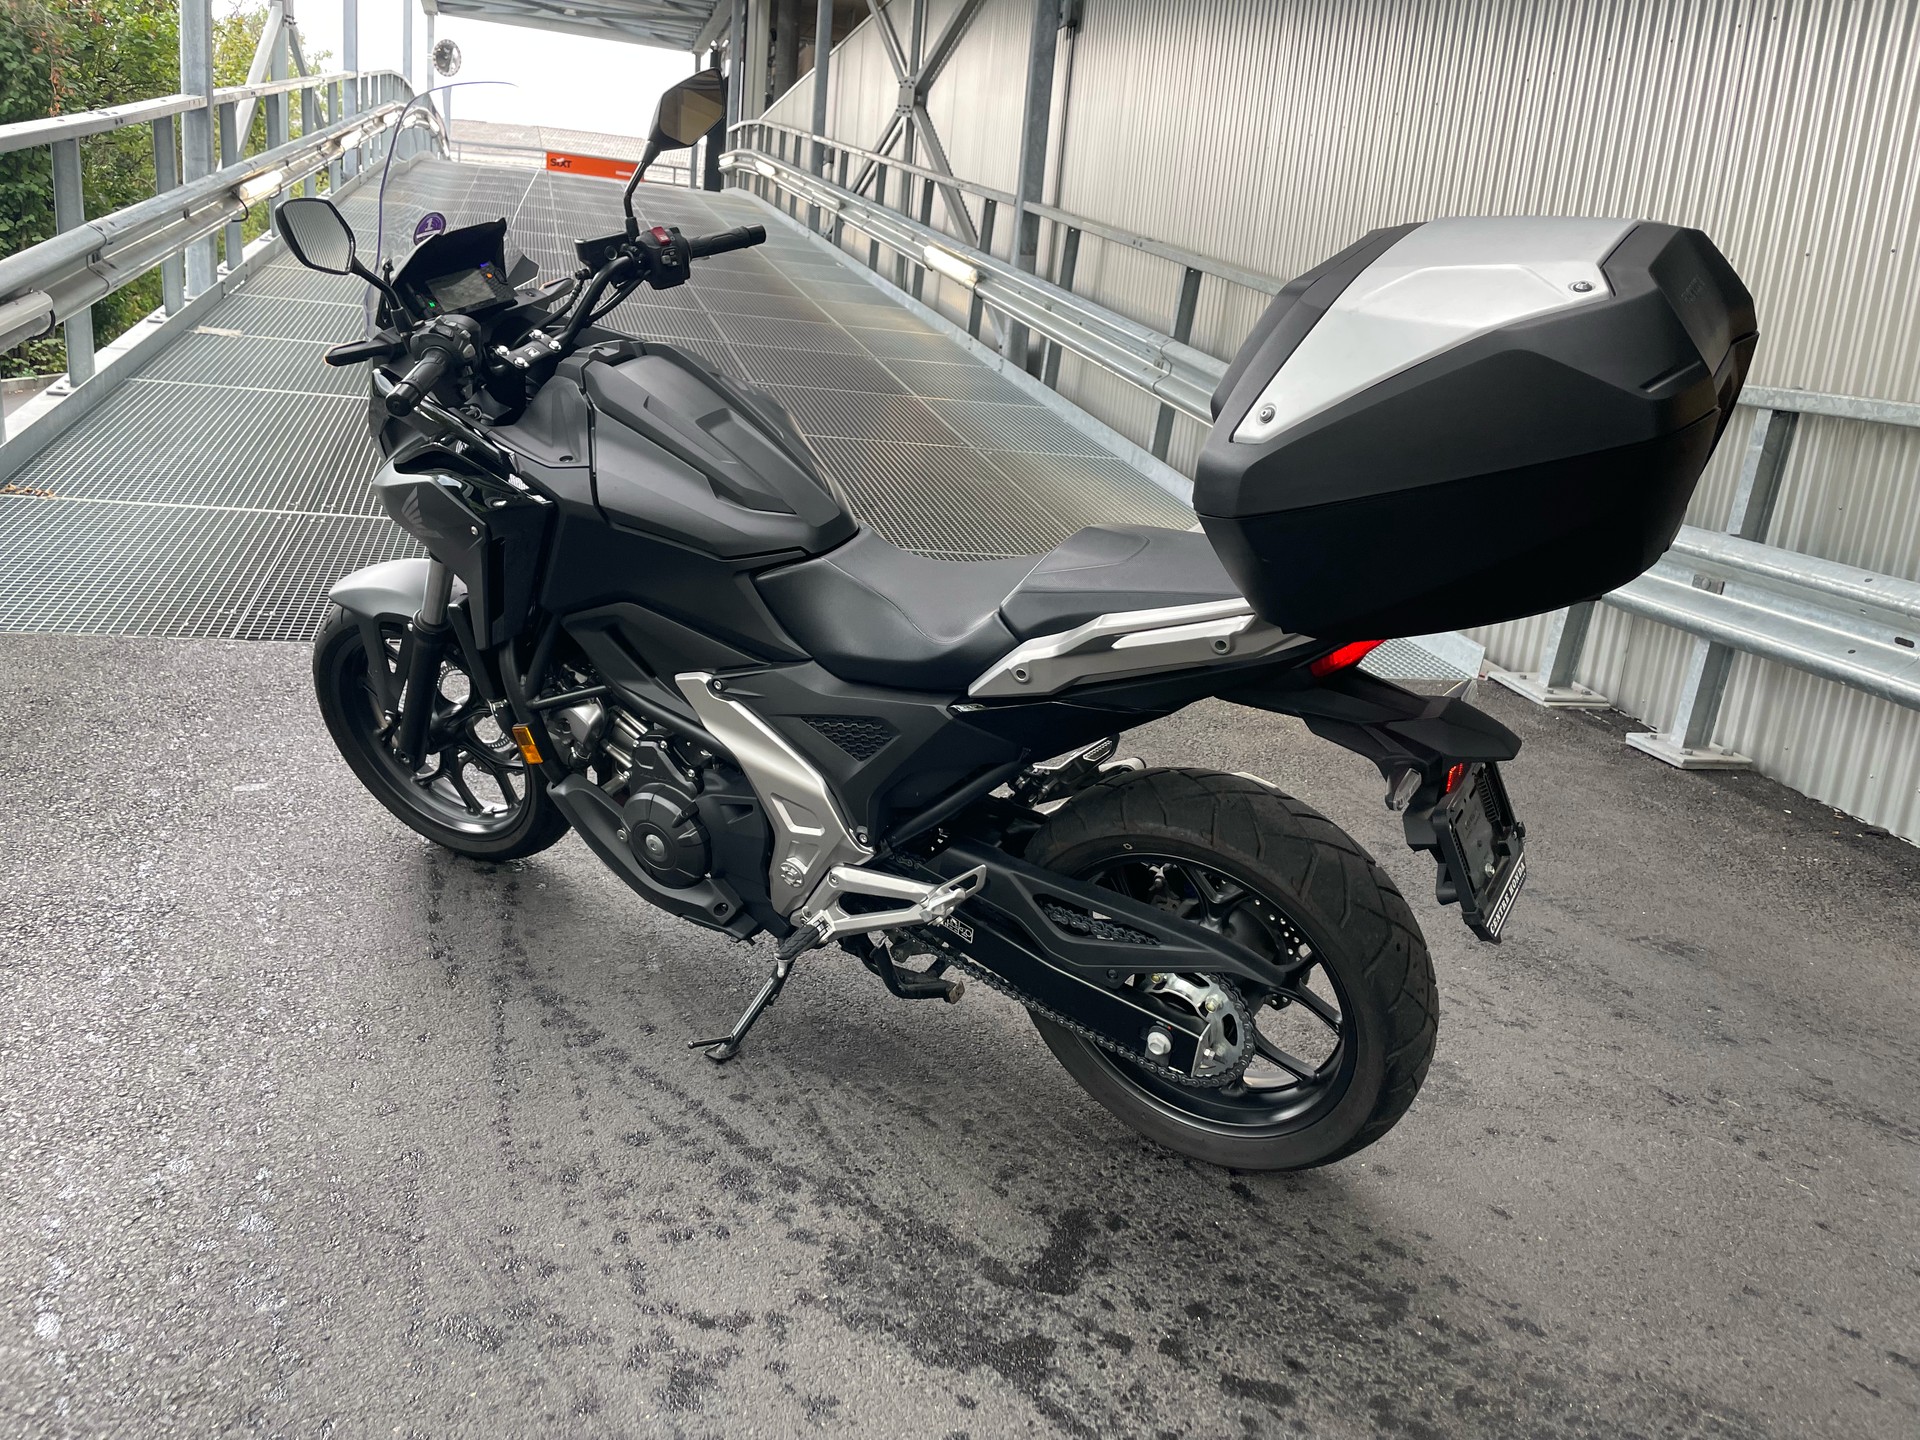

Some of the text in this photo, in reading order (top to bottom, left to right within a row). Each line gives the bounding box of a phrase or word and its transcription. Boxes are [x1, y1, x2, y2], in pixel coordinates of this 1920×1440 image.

[550, 157, 572, 169] SIXT
[424, 217, 434, 231] 1
[1489, 892, 1510, 934] CENTRE
[1508, 861, 1526, 896] HONDA
